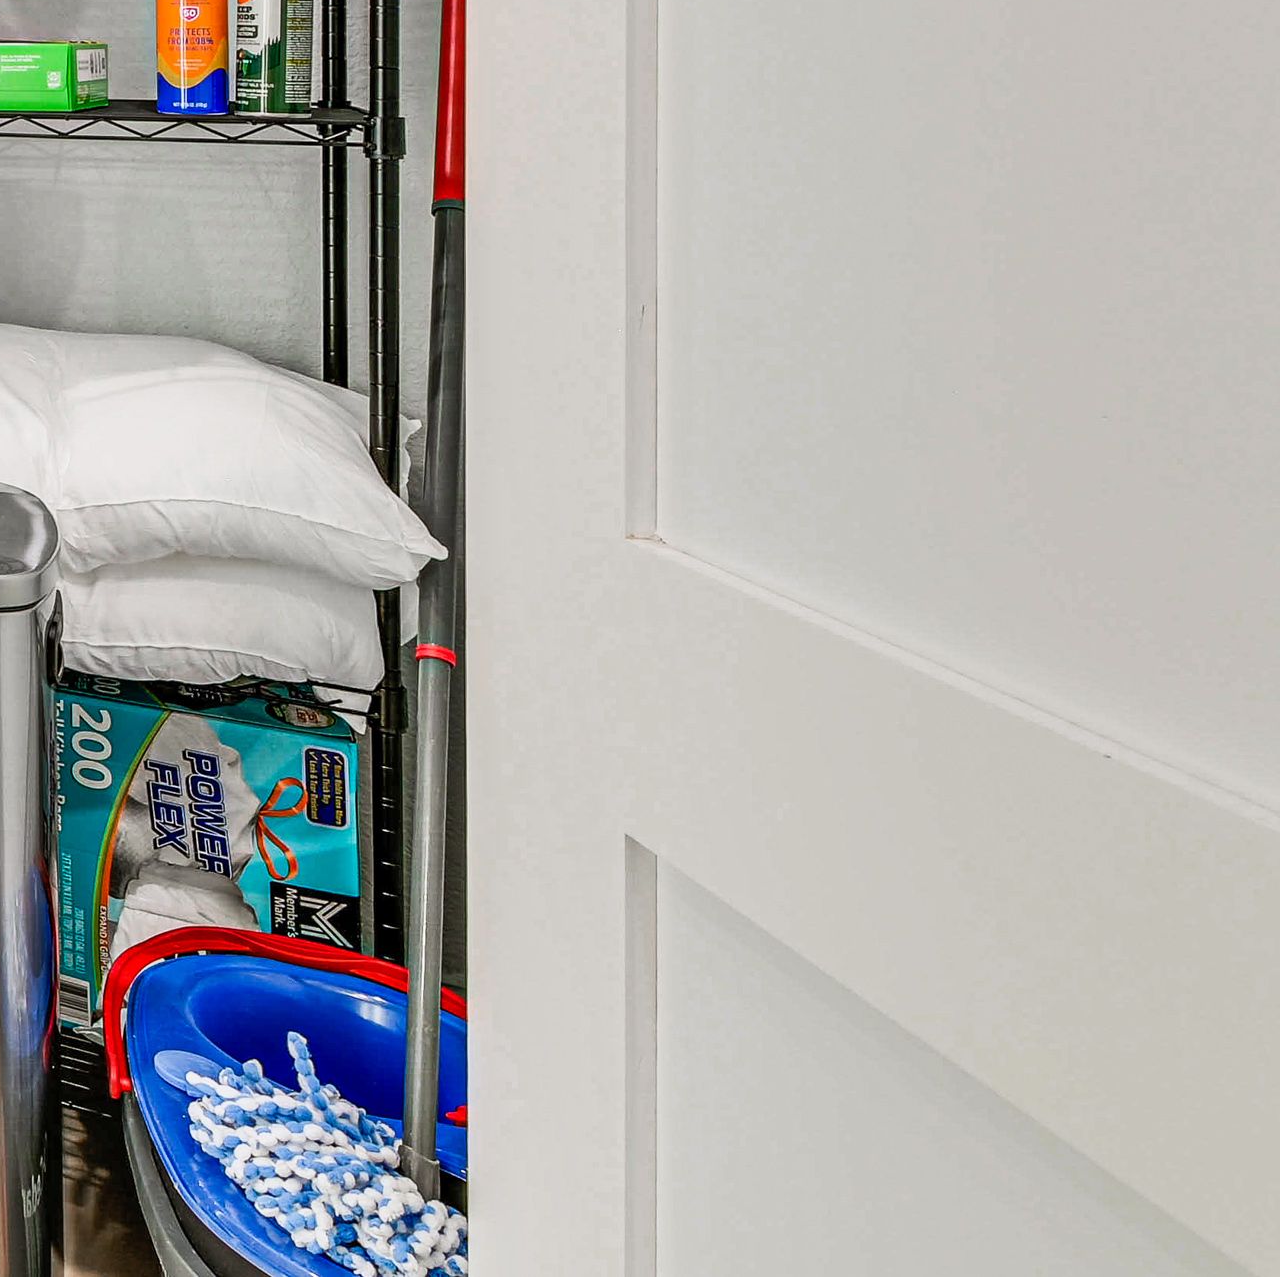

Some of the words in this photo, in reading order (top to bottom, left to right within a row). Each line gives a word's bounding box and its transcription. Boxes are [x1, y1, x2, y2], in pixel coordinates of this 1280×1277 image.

[93, 677, 121, 695] 00
[71, 703, 113, 790] 200
[144, 759, 190, 859] FLEX
[182, 748, 234, 880] POWER
[99, 905, 107, 938] EXPAND
[286, 887, 299, 939] Member's
